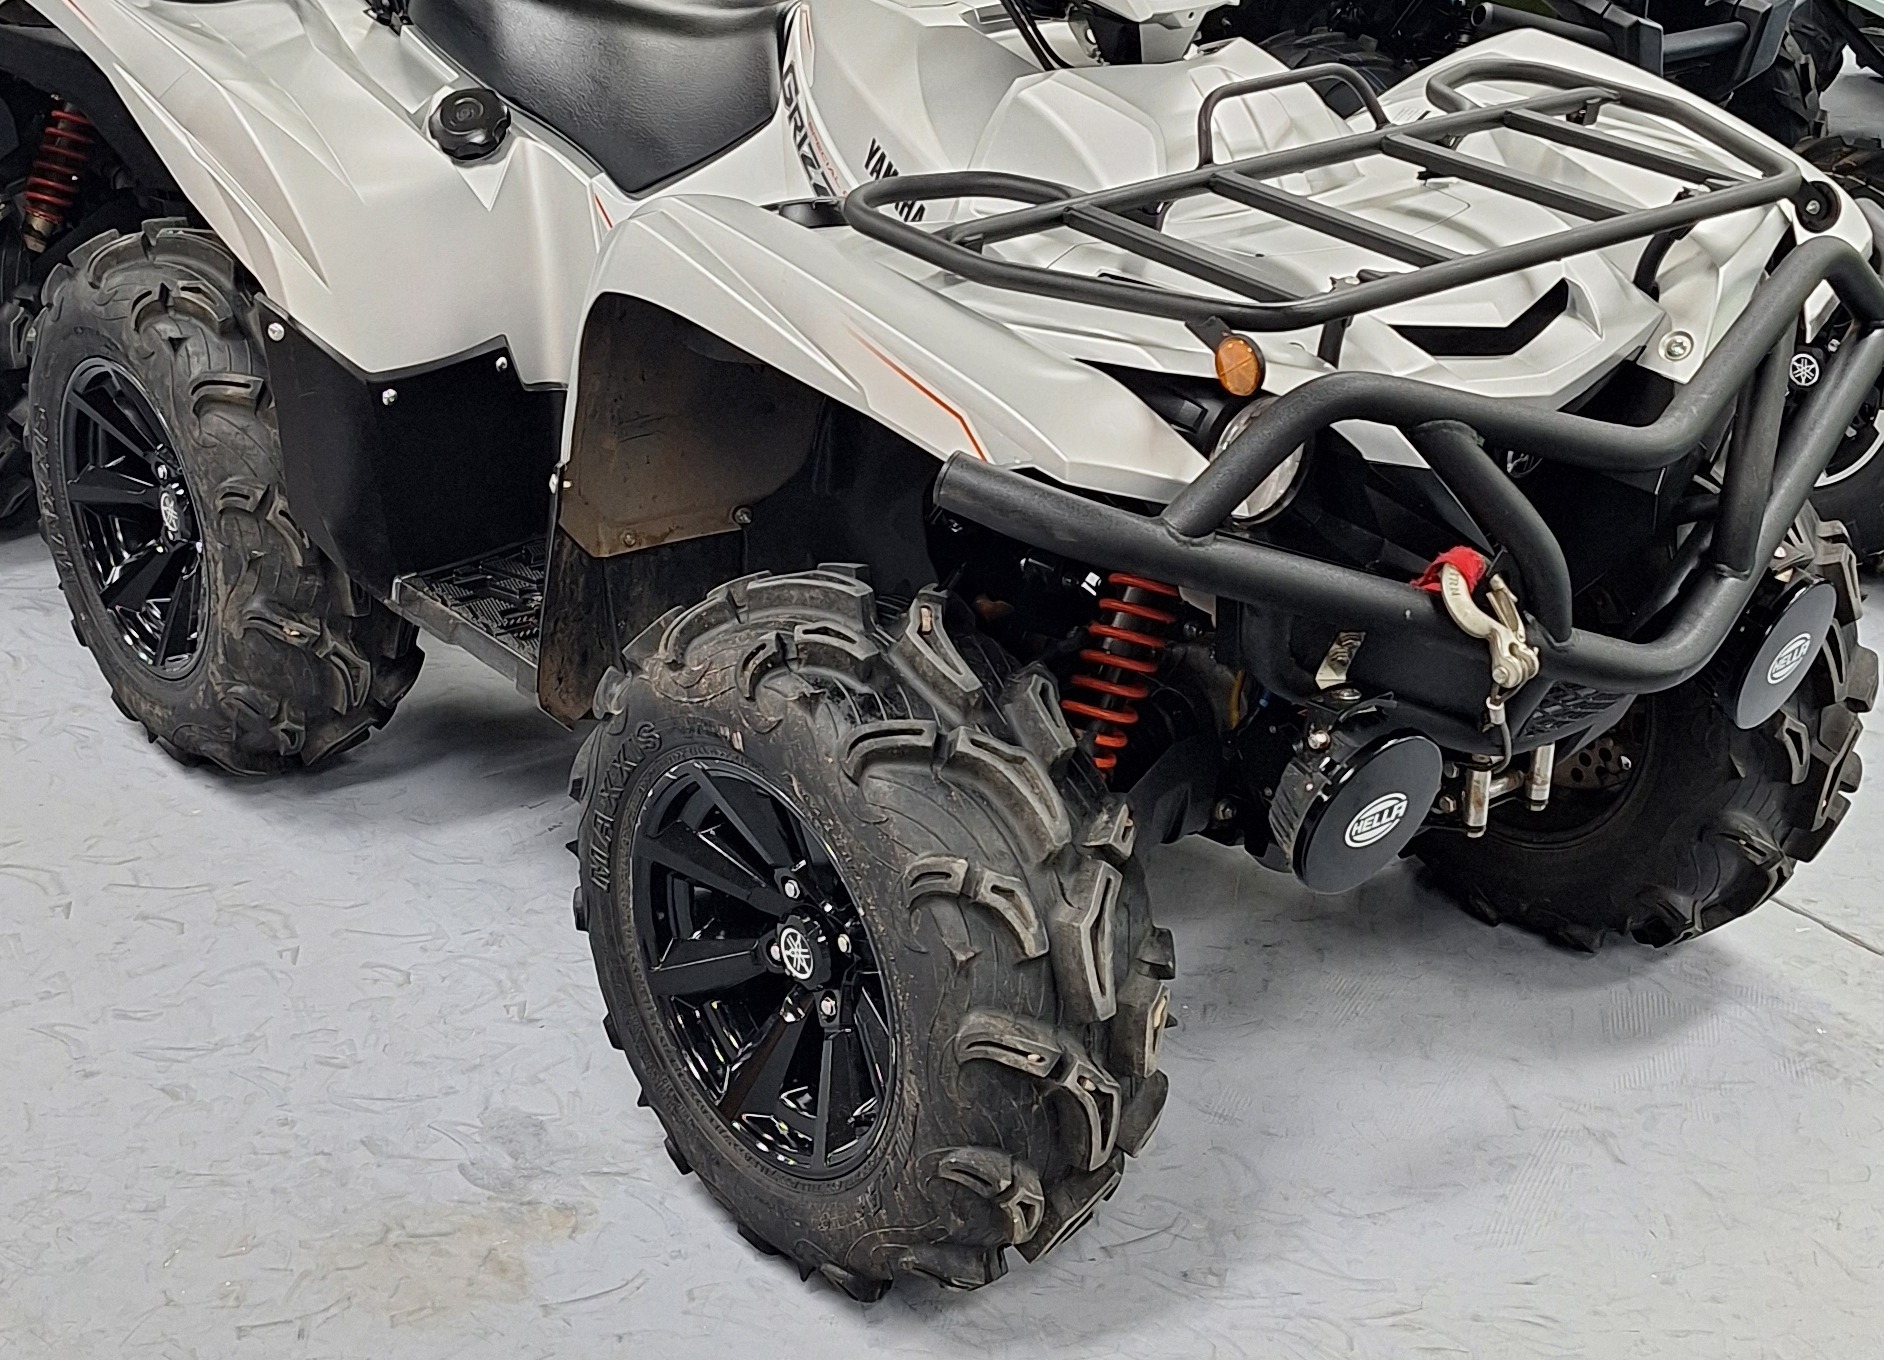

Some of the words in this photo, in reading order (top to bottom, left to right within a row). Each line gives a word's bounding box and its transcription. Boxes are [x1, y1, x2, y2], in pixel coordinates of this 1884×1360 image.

[782, 59, 837, 198] GRIZZ
[863, 137, 926, 223] YAMHA
[1771, 639, 1811, 674] HELLA
[589, 720, 663, 894] MAXXIS
[1351, 799, 1408, 837] HELLA
